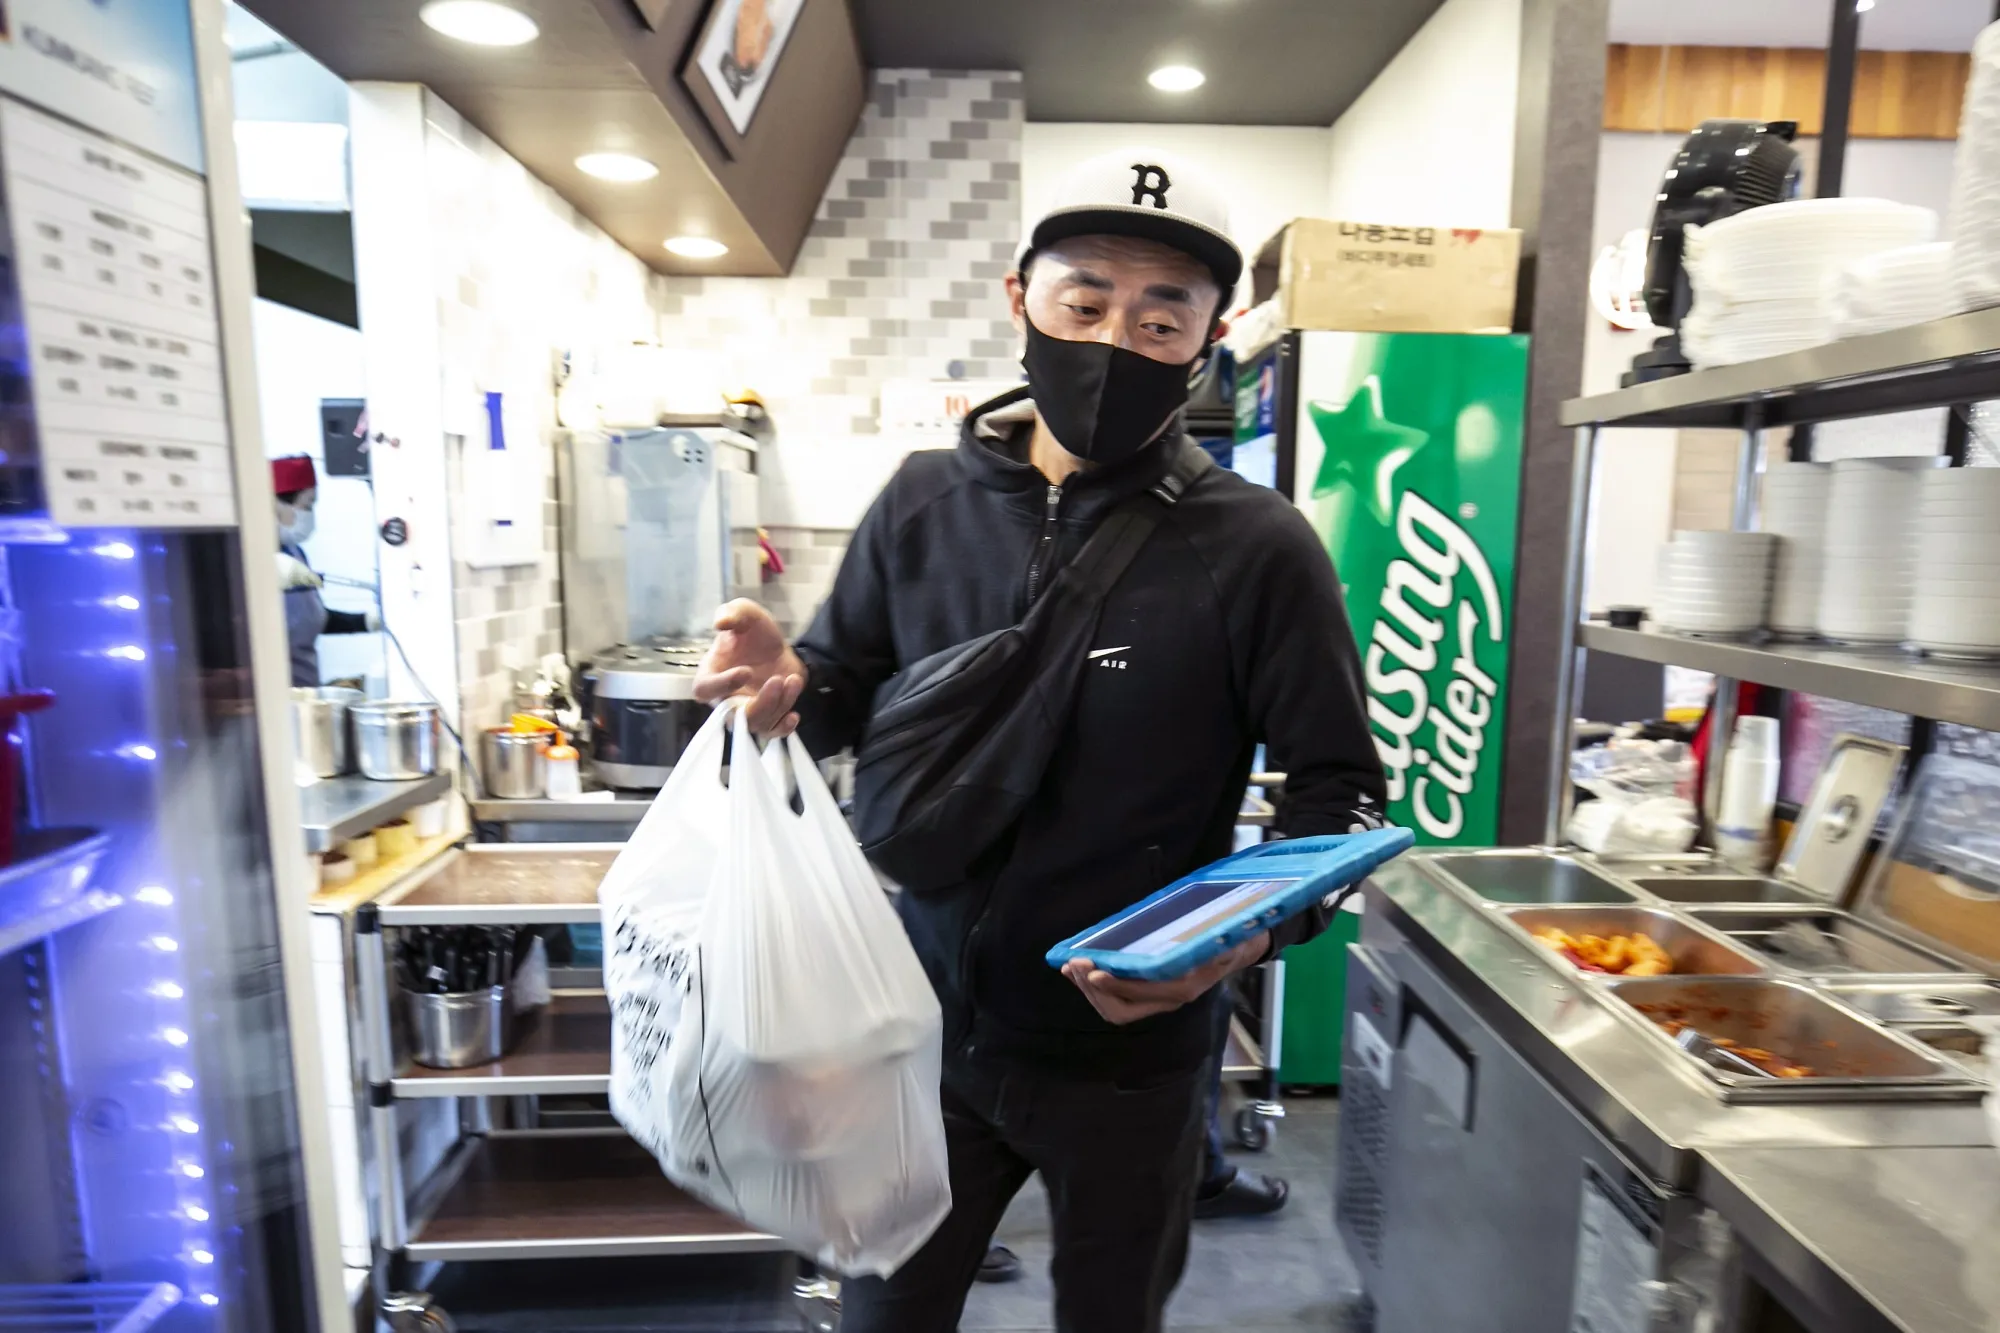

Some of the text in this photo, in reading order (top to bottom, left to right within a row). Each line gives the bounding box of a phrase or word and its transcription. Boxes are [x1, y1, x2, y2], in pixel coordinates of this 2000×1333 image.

[1130, 163, 1172, 209] R
[1100, 659, 1128, 669] AIR
[1365, 489, 1503, 802] sung
[1412, 598, 1499, 840] Cider
